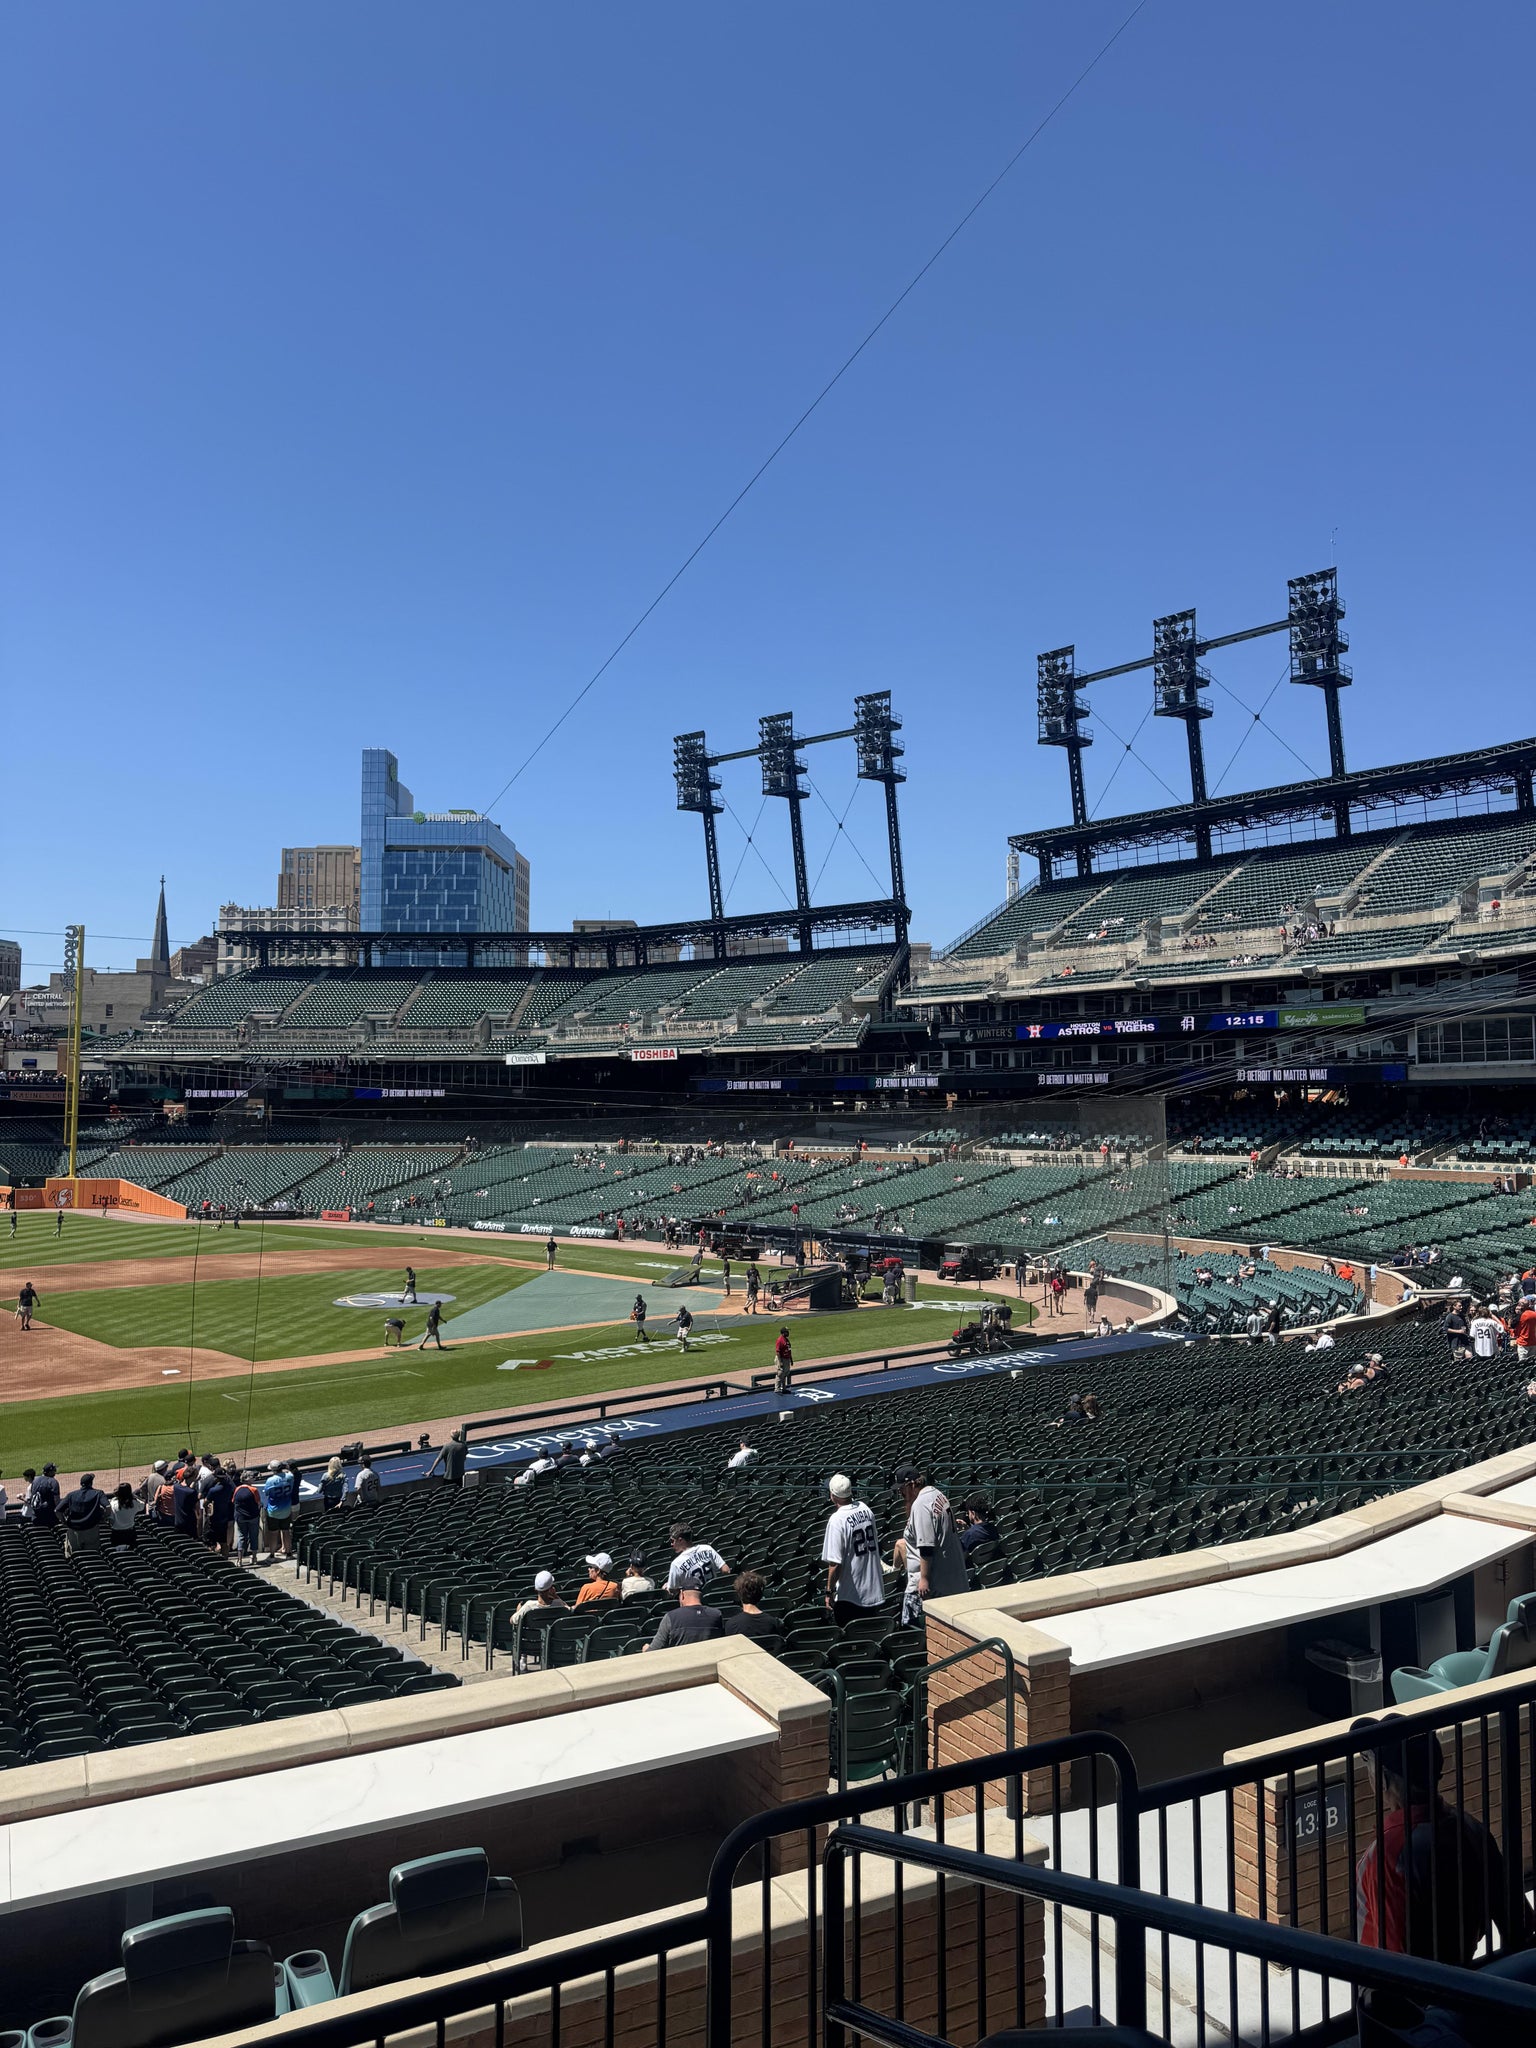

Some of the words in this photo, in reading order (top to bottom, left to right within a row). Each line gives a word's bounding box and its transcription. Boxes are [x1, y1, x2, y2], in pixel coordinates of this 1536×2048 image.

[427, 813, 482, 825] Huntington
[1225, 1015, 1265, 1026] 12:15
[976, 1028, 1013, 1038] WINTER'S
[1058, 1027, 1101, 1037] ASTROS
[1116, 1023, 1156, 1034] TIGERS
[633, 1049, 676, 1060] TOSHIBA
[1247, 1069, 1271, 1082] DETROIT
[1273, 1069, 1282, 1081] NO
[1283, 1069, 1308, 1081] MATTER
[1309, 1068, 1328, 1081] WHAT
[424, 1217, 447, 1227] bet365
[1477, 1328, 1491, 1339] 24
[852, 1525, 877, 1557] 29
[1304, 1799, 1318, 1809] LOGE
